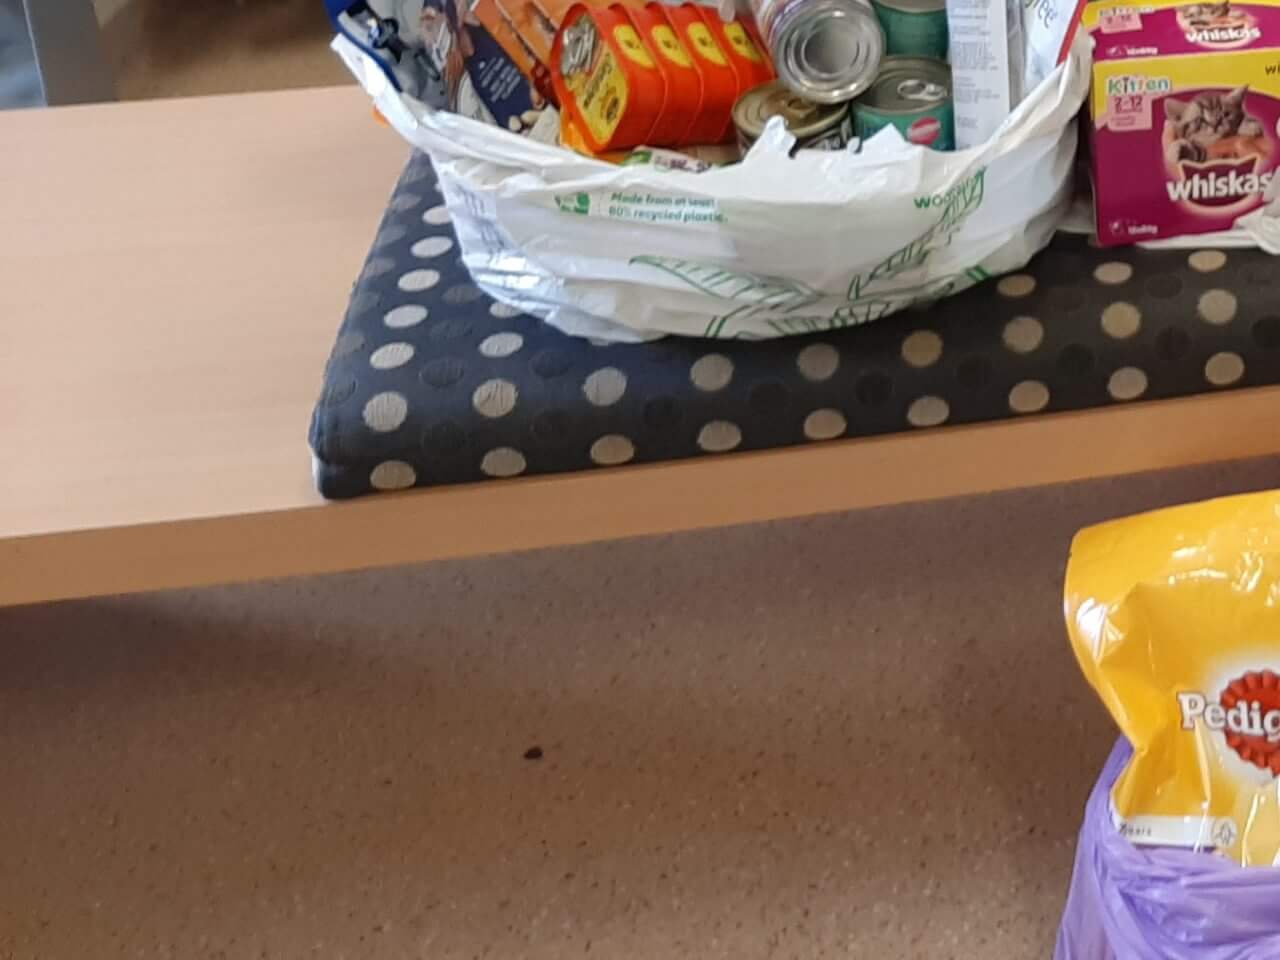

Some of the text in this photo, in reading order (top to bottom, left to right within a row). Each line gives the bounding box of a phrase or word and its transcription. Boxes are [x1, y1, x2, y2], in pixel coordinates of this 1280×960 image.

[1185, 25, 1262, 42] whiskas
[1108, 76, 1169, 95] Kitten
[1166, 171, 1277, 201] whiskas
[611, 191, 643, 206] Made
[645, 193, 672, 206] from
[633, 207, 682, 222] recycled
